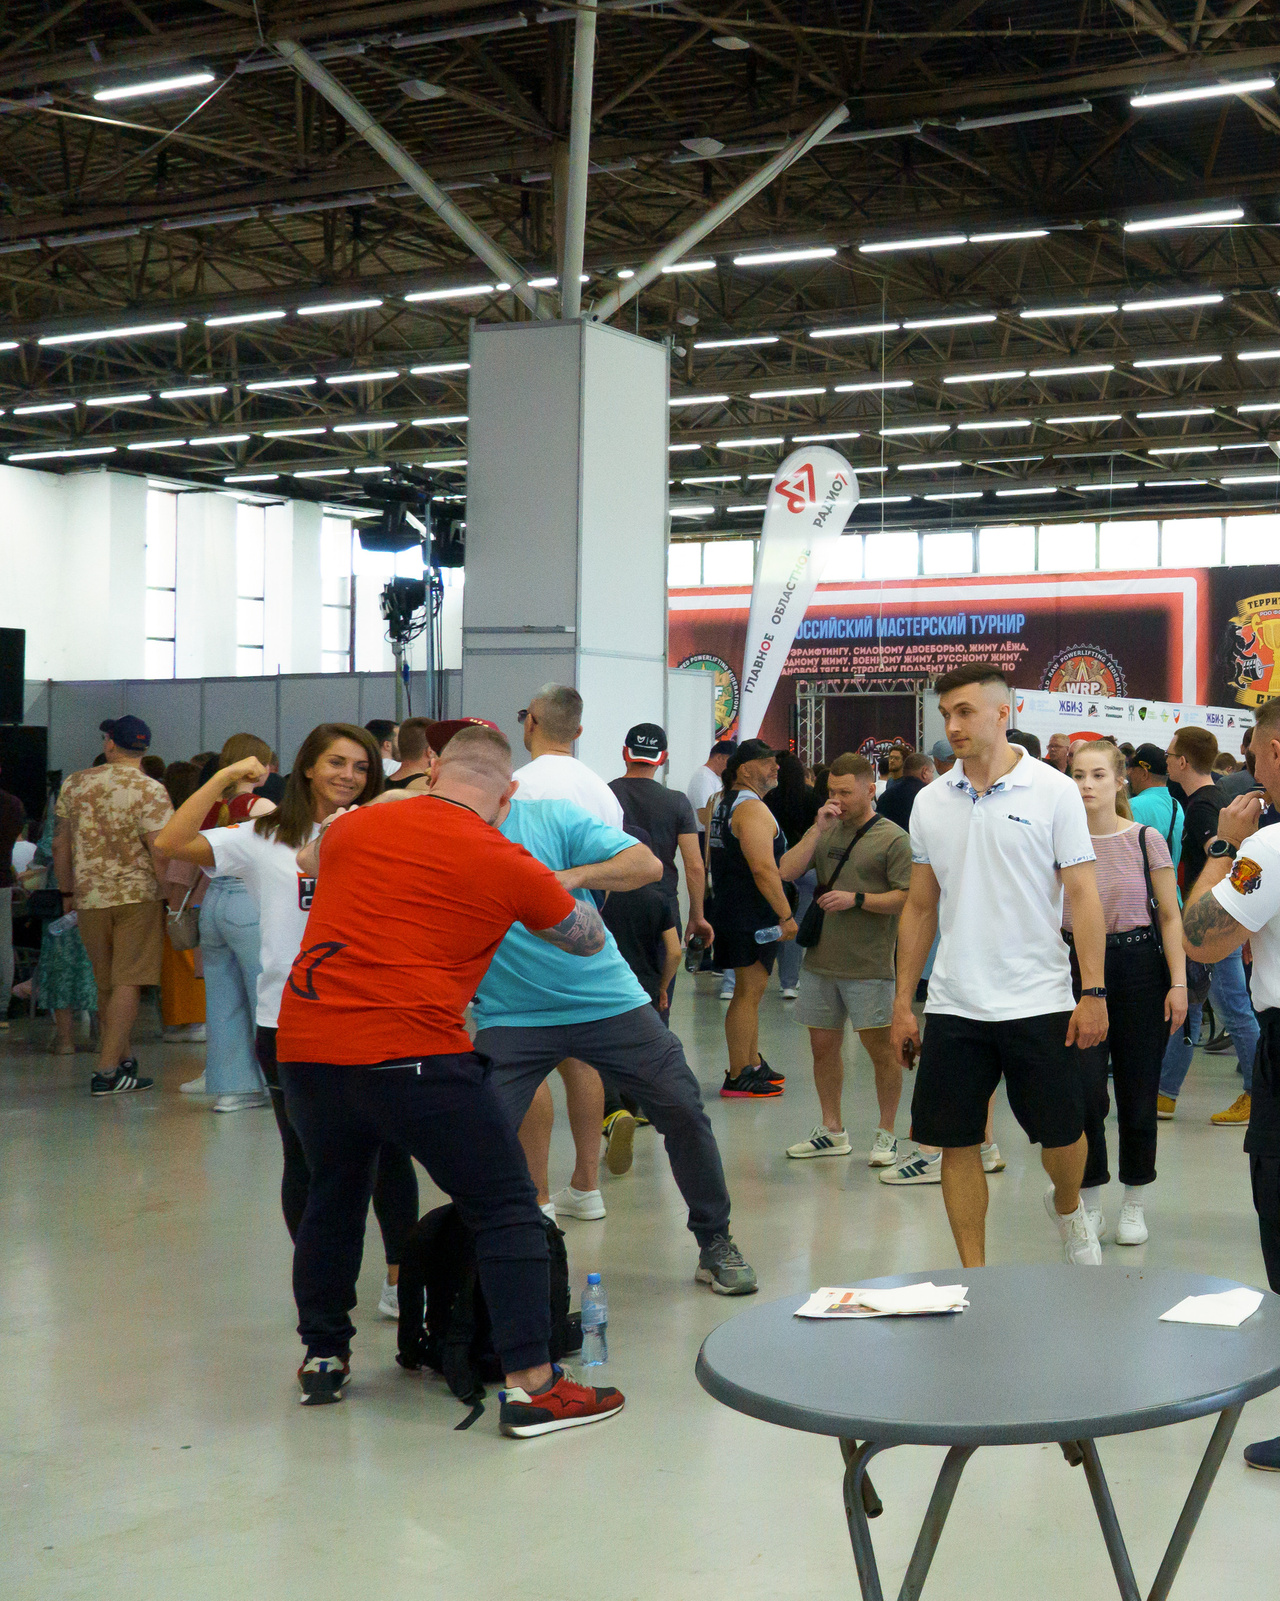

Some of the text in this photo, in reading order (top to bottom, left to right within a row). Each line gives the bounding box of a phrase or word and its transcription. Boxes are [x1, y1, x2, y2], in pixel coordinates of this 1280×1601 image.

[745, 547, 812, 694] ГЛАВНОЕ ОБЛАСТНОЕ
[796, 613, 1026, 640] ОССИЙСКИЙ МАСТЕРСКИЙ ТУРНИР
[783, 652, 1022, 667] ОДНОМУ ЖИМУ, ВОЕННОМУ ЖИМУ, РУССКОМУ ЖИМУ,
[790, 641, 1029, 657] ЭРЛИФТИНГУ, СИЛОВОМУ ДВОЕБОРЬЮ, ЖИМУ ЛЁЖА,
[781, 665, 818, 675] АНОВОЙ
[1002, 663, 1015, 671] ПО
[1060, 650, 1107, 663] POWERLIFTING
[1107, 662, 1122, 697] FEDERATIO
[690, 655, 729, 671] POWERLIFTING
[728, 670, 740, 710] FEDERATION
[1059, 700, 1083, 714] ЖБИ-3
